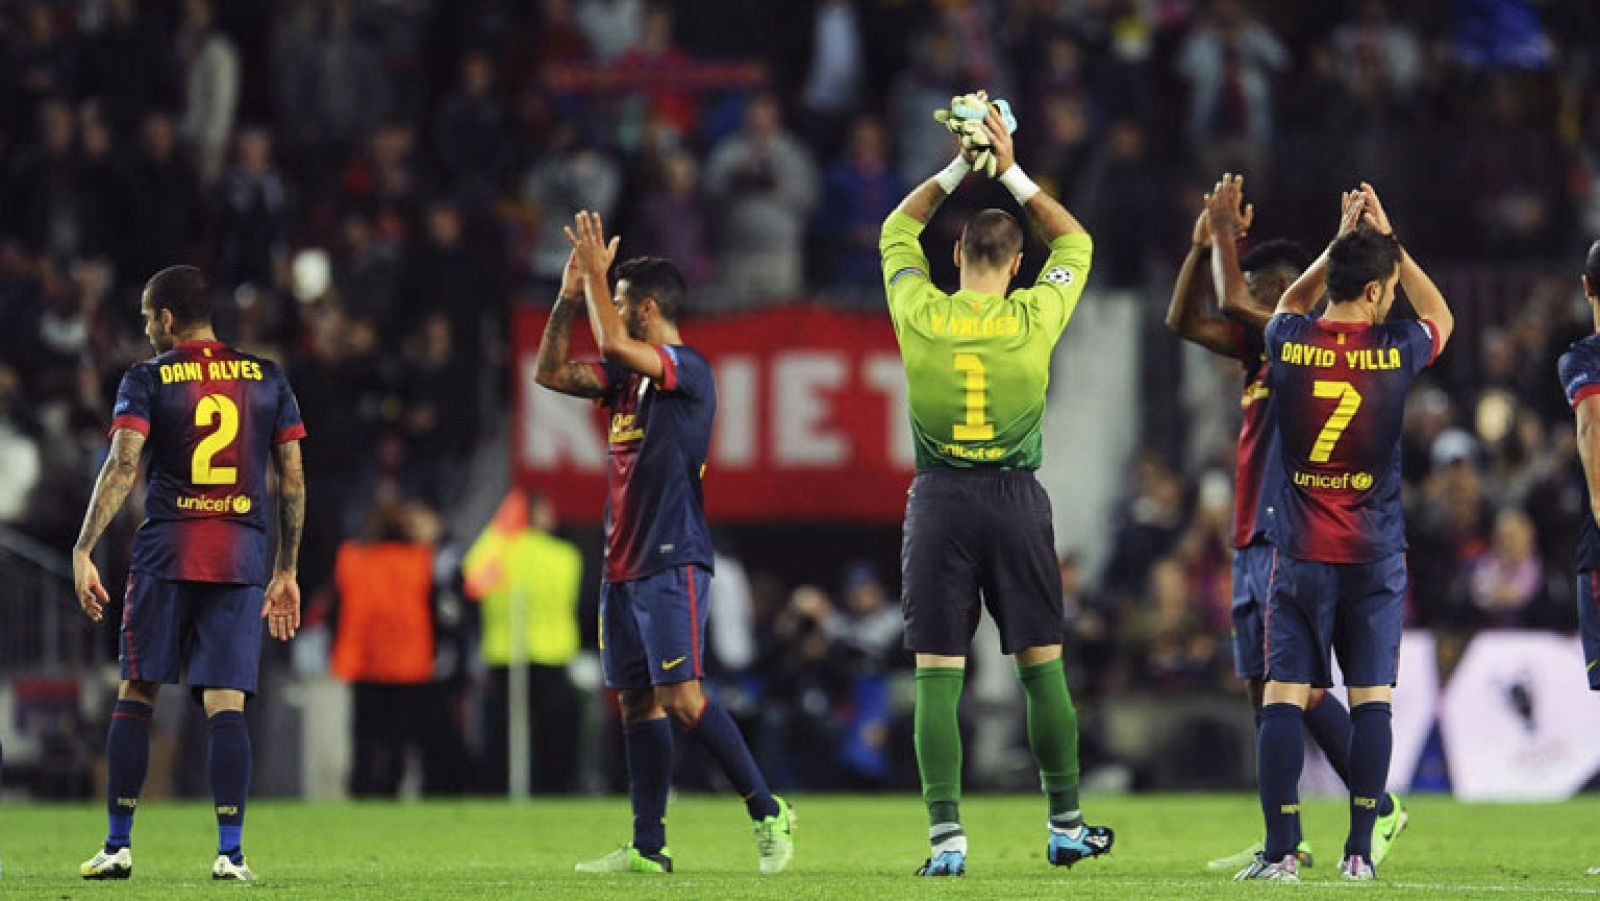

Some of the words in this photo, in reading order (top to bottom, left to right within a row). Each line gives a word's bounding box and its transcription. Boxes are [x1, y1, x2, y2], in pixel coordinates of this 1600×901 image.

[1282, 342, 1336, 367] DAVID
[1346, 348, 1401, 370] VILLA
[160, 363, 202, 384] DANI
[208, 360, 263, 381] ALVES
[953, 353, 995, 440] 1
[1309, 381, 1363, 463] 7
[191, 394, 239, 484] 2
[1294, 471, 1350, 489] unicef
[177, 495, 232, 513] unicef
